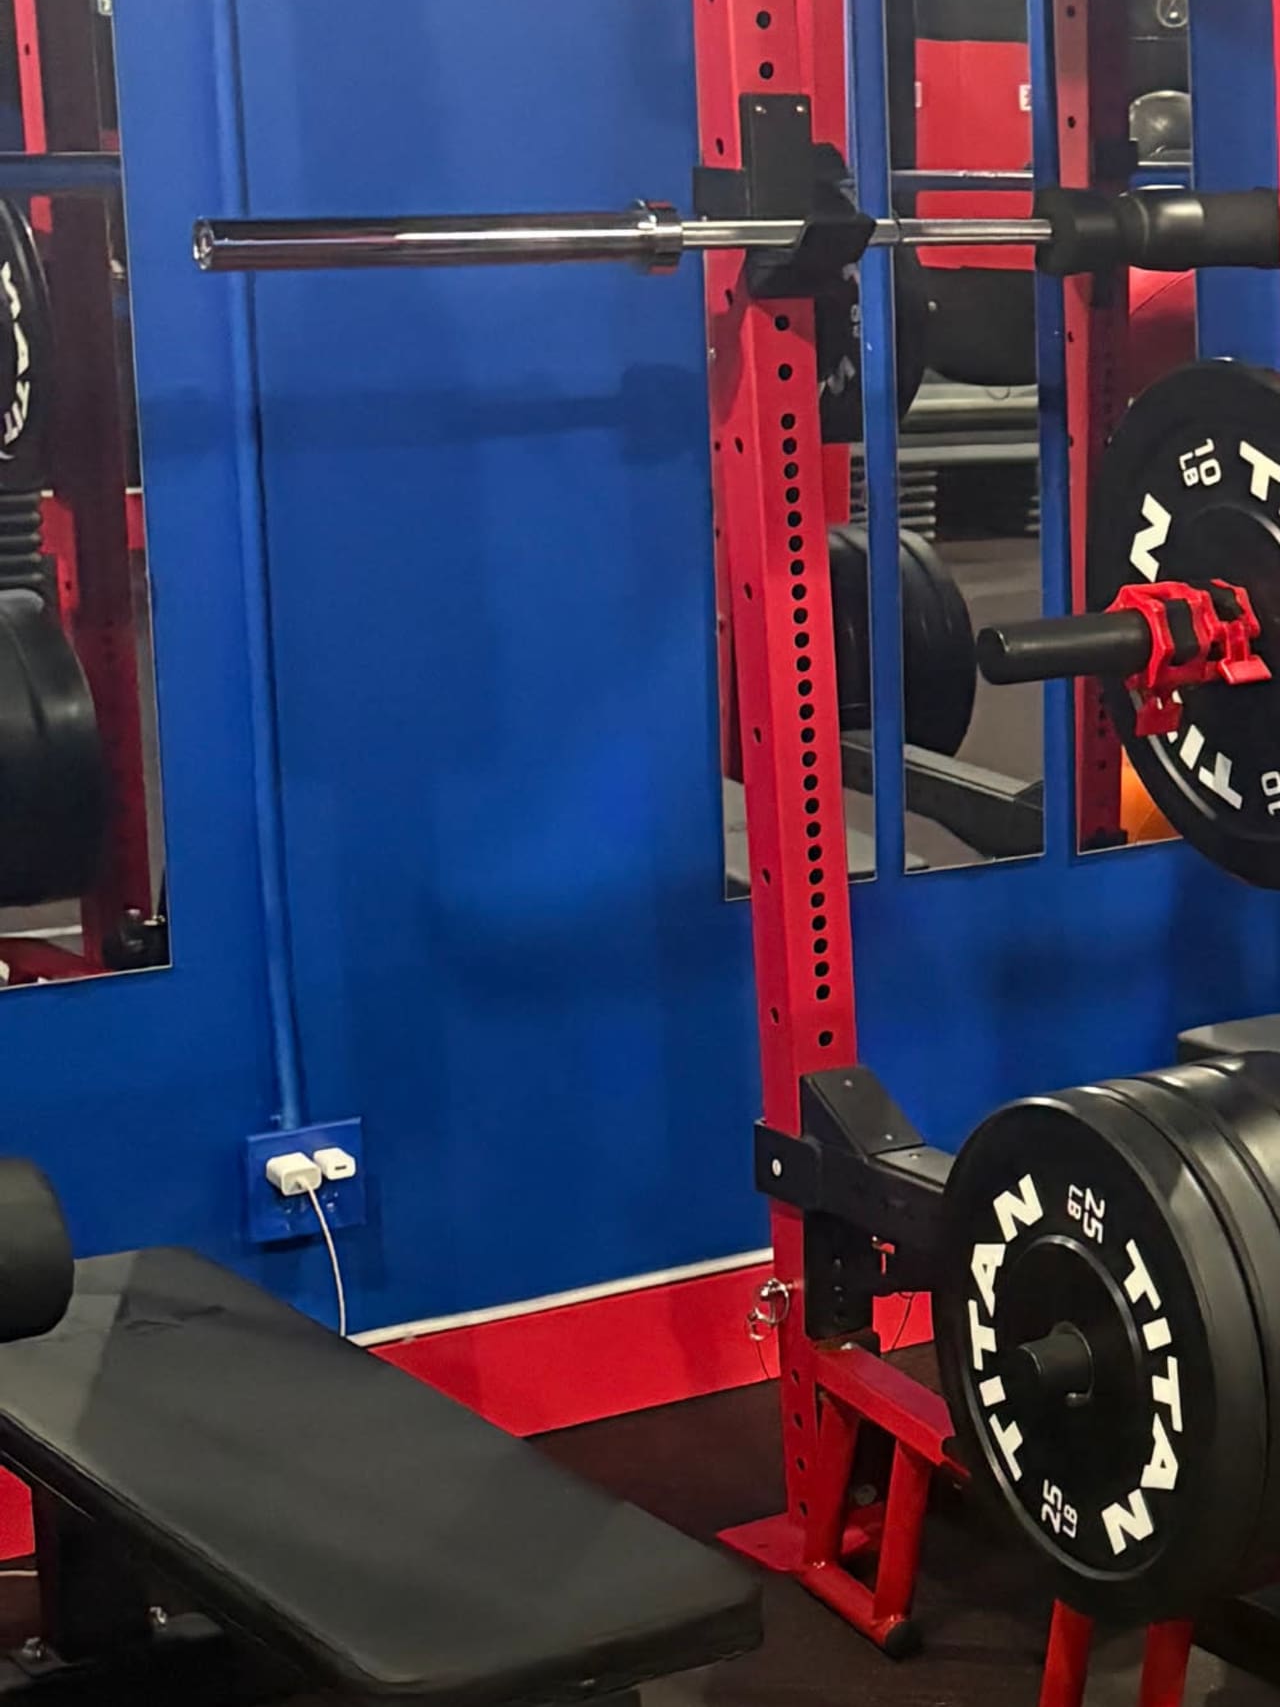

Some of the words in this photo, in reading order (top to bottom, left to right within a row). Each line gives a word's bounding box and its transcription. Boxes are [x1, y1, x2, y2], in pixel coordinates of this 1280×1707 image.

[1179, 451, 1199, 487] LB
[1194, 437, 1223, 487] 10
[1129, 493, 1243, 811] TIN
[1066, 1183, 1084, 1223] LB
[1082, 1186, 1106, 1245] 25
[968, 1173, 1045, 1481] TITAN
[1100, 1239, 1183, 1556] TITAN
[1040, 1477, 1064, 1535] 25
[1060, 1503, 1078, 1539] LB
